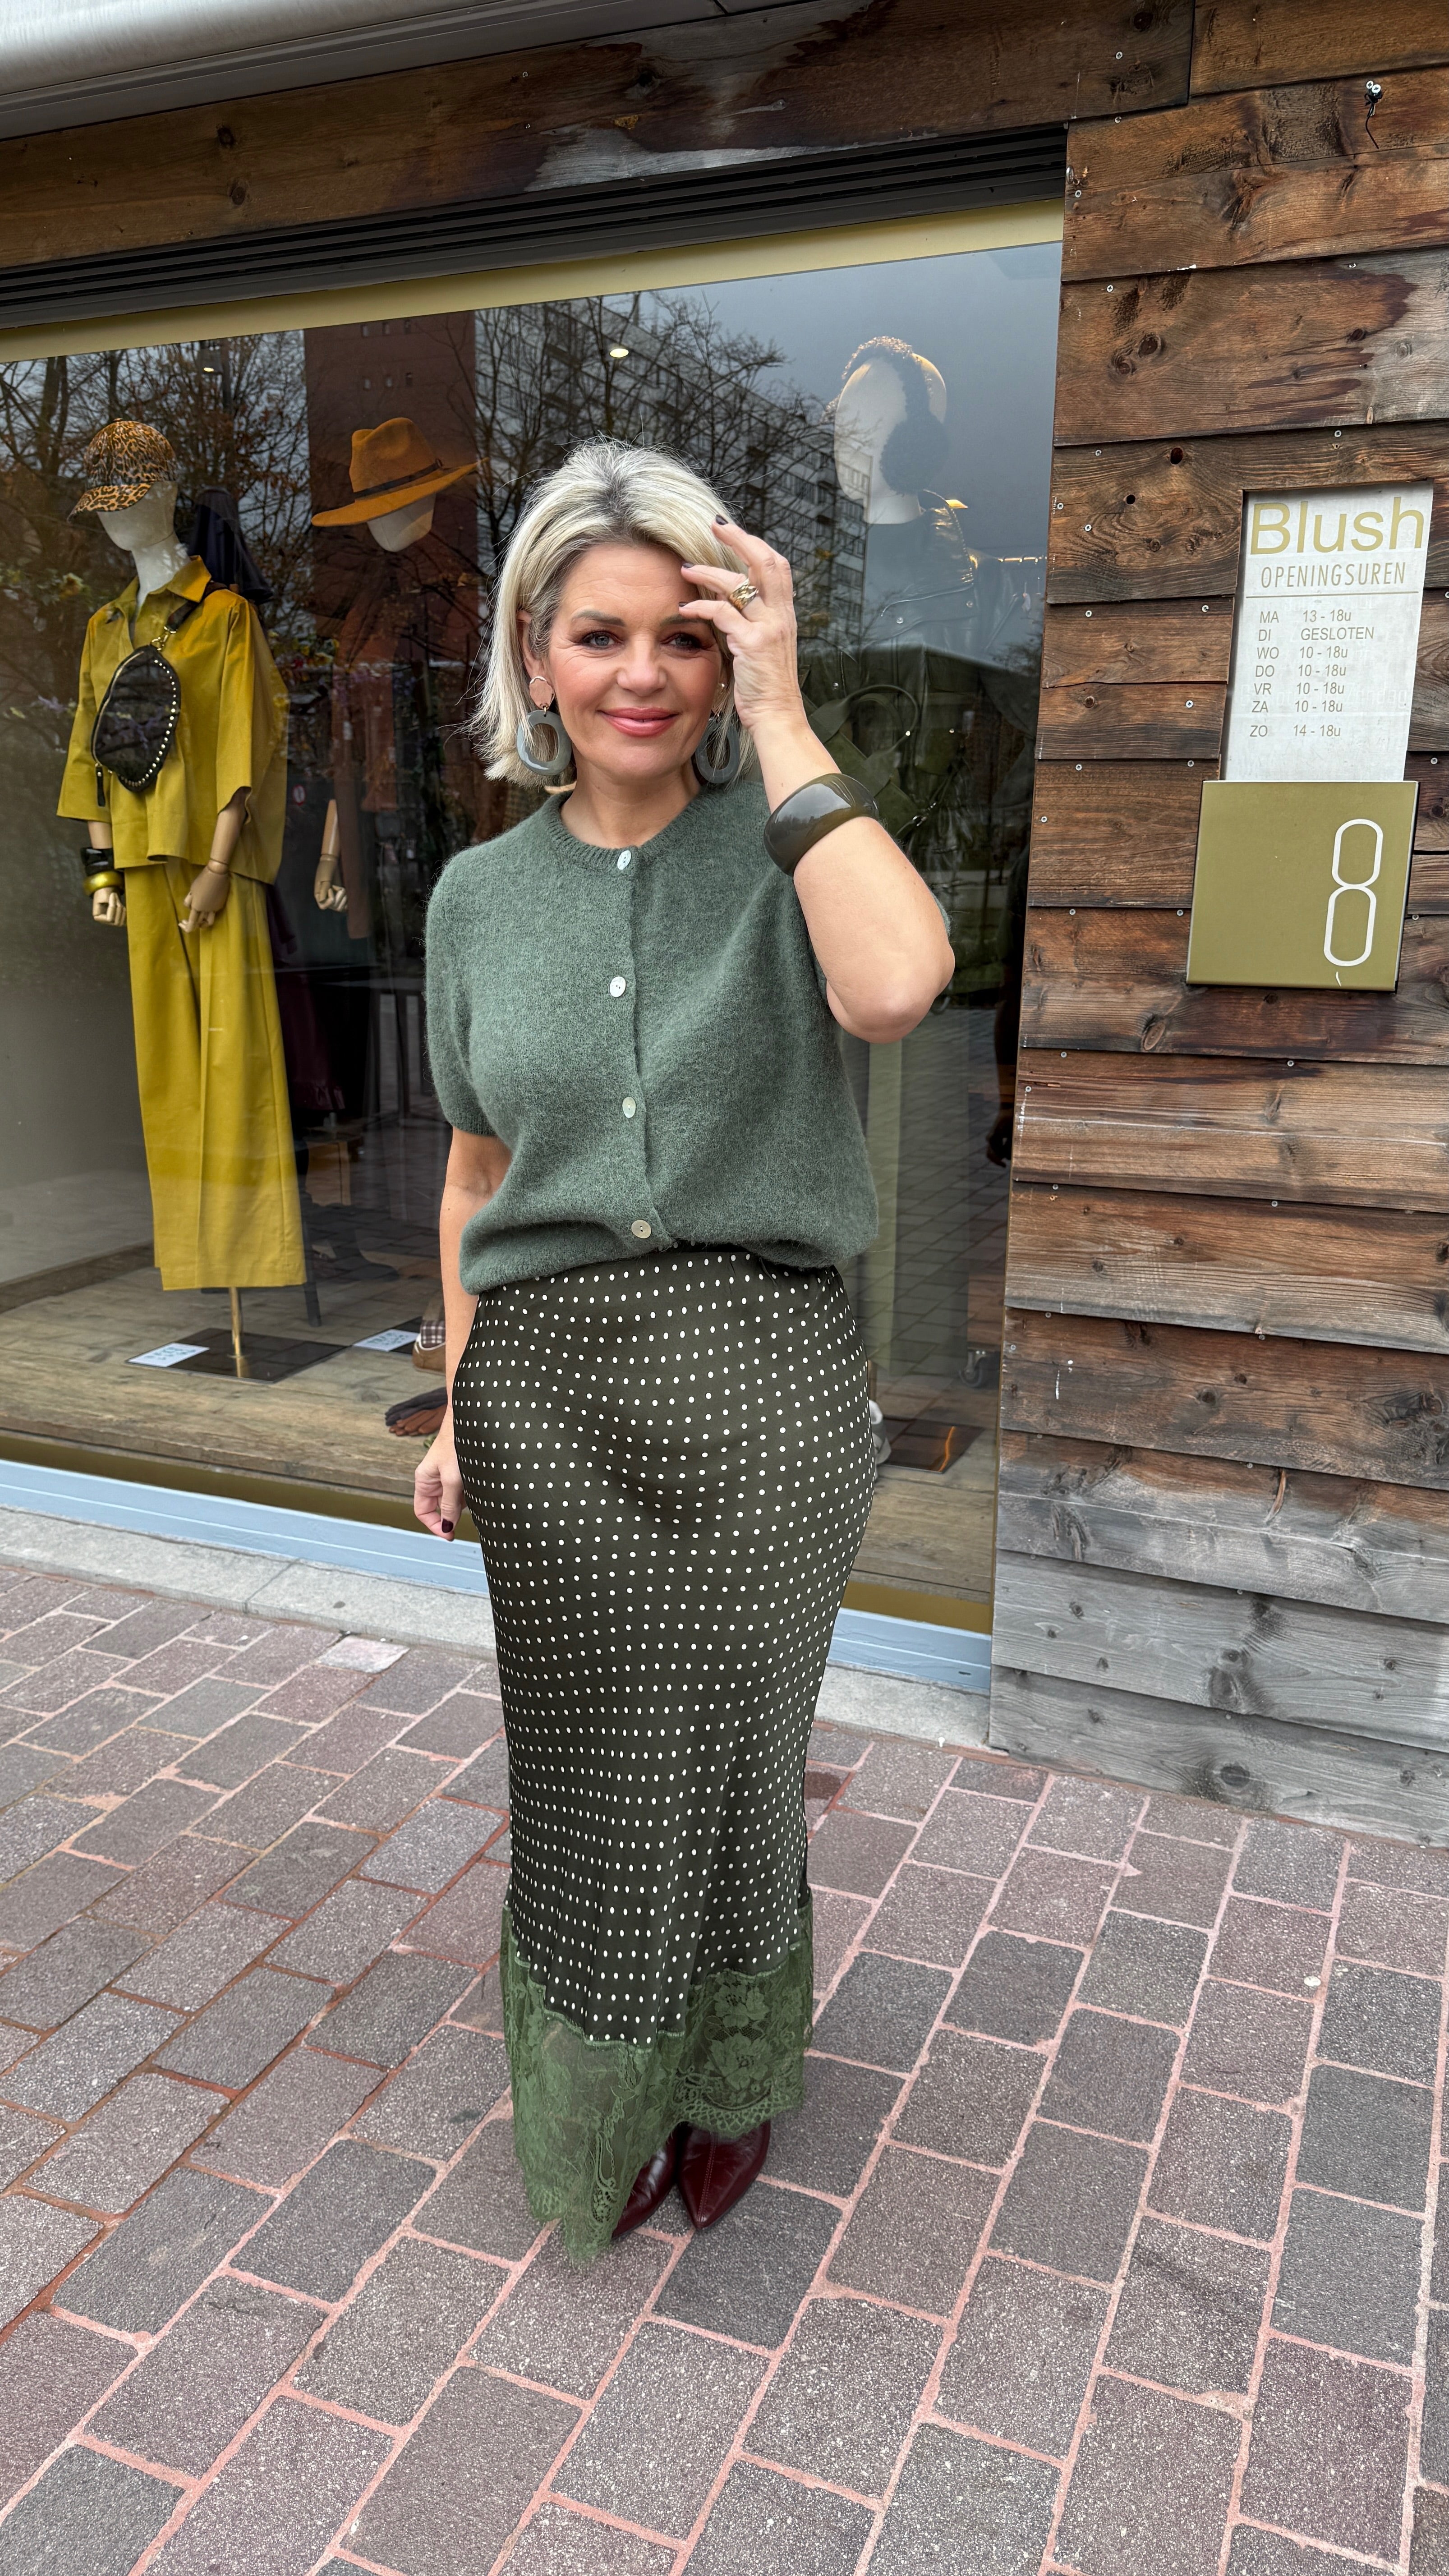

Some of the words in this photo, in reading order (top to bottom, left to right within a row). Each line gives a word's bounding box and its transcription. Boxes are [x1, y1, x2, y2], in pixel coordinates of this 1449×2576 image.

[1251, 497, 1424, 555] Blush
[1261, 562, 1405, 588] OPENINGSUREN
[1260, 611, 1279, 623] MA
[1303, 610, 1316, 622] 13
[1330, 609, 1351, 621] 18u
[1259, 629, 1271, 641] DI
[1301, 627, 1374, 640] GESLOTEN
[1257, 647, 1279, 659] WO
[1300, 647, 1313, 658] 10
[1327, 646, 1348, 658] 18u
[1256, 665, 1274, 677] DO
[1299, 665, 1311, 676] 10
[1325, 664, 1346, 676] 18u
[1254, 683, 1271, 695] VR
[1297, 682, 1310, 694] 10
[1324, 682, 1344, 694] 18u
[1252, 701, 1268, 713] ZA
[1295, 700, 1308, 712] 10
[1322, 700, 1343, 712] 18u
[1250, 725, 1267, 737] ZO
[1294, 725, 1306, 736] 14
[1320, 725, 1340, 736] 18u
[1324, 819, 1383, 966] 8
